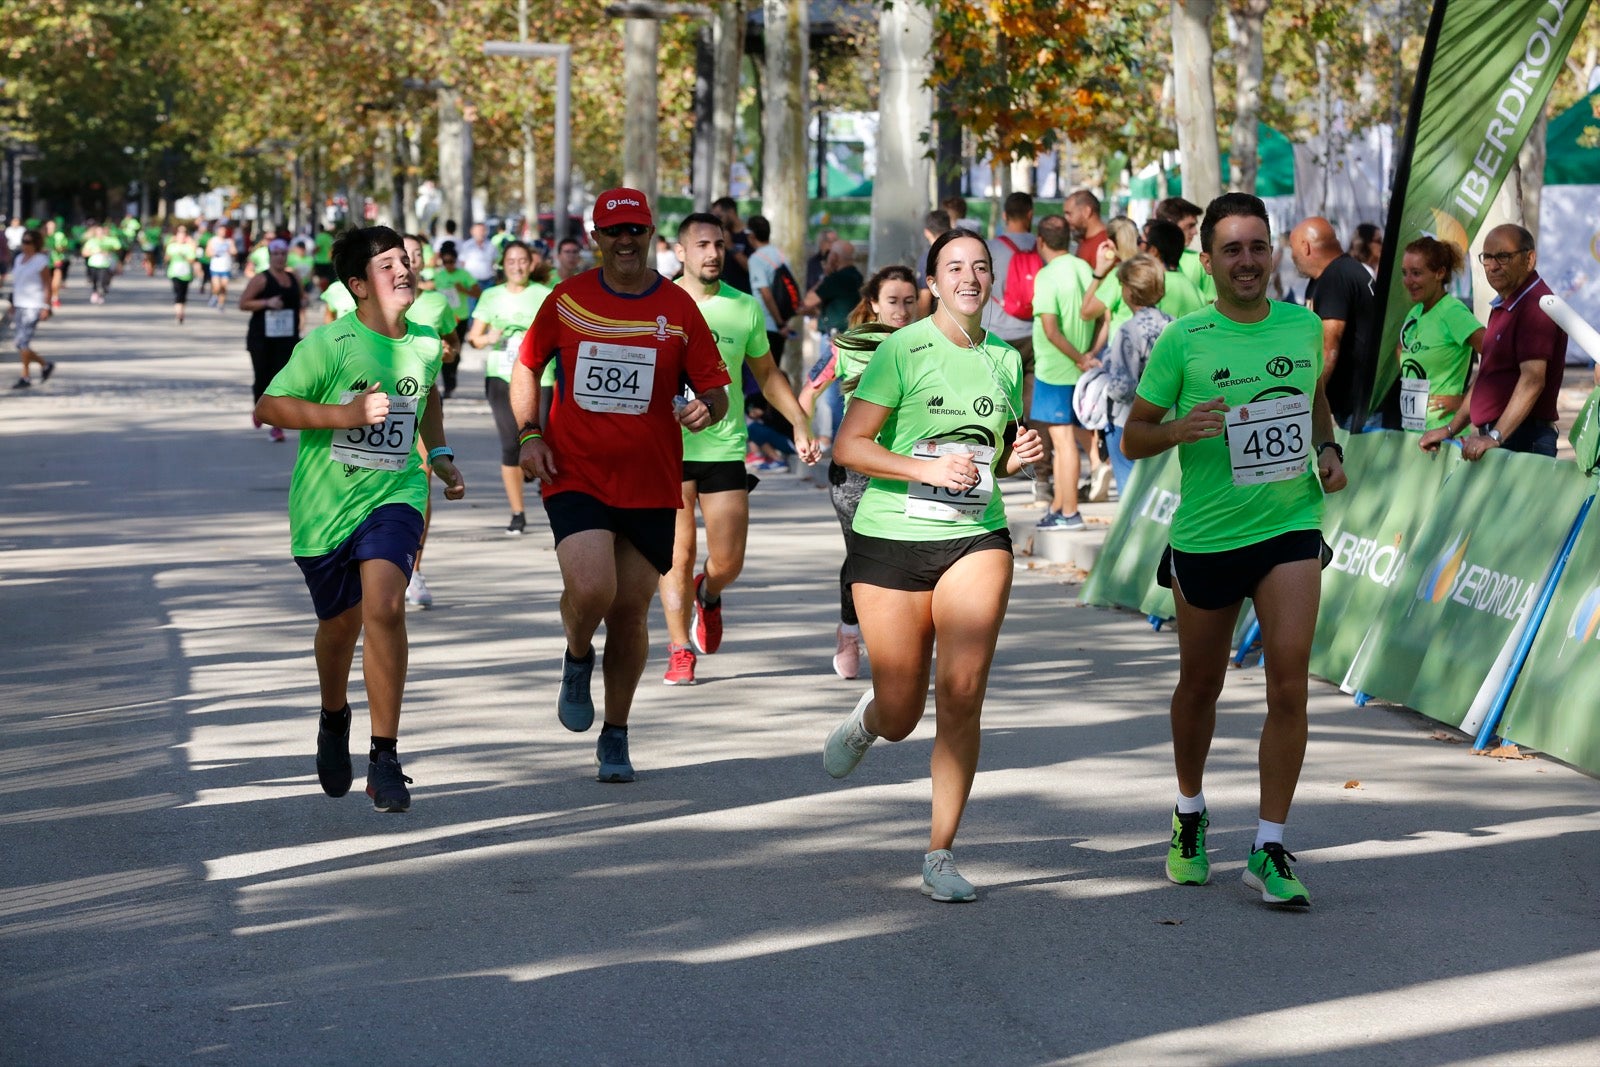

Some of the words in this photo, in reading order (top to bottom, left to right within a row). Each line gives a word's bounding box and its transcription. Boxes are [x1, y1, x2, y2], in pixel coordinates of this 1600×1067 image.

[586, 366, 640, 395] 584
[1217, 376, 1261, 389] IBERDROLA
[929, 408, 967, 416] IBERDROLA
[346, 420, 404, 449] 585
[1243, 423, 1304, 459] 483
